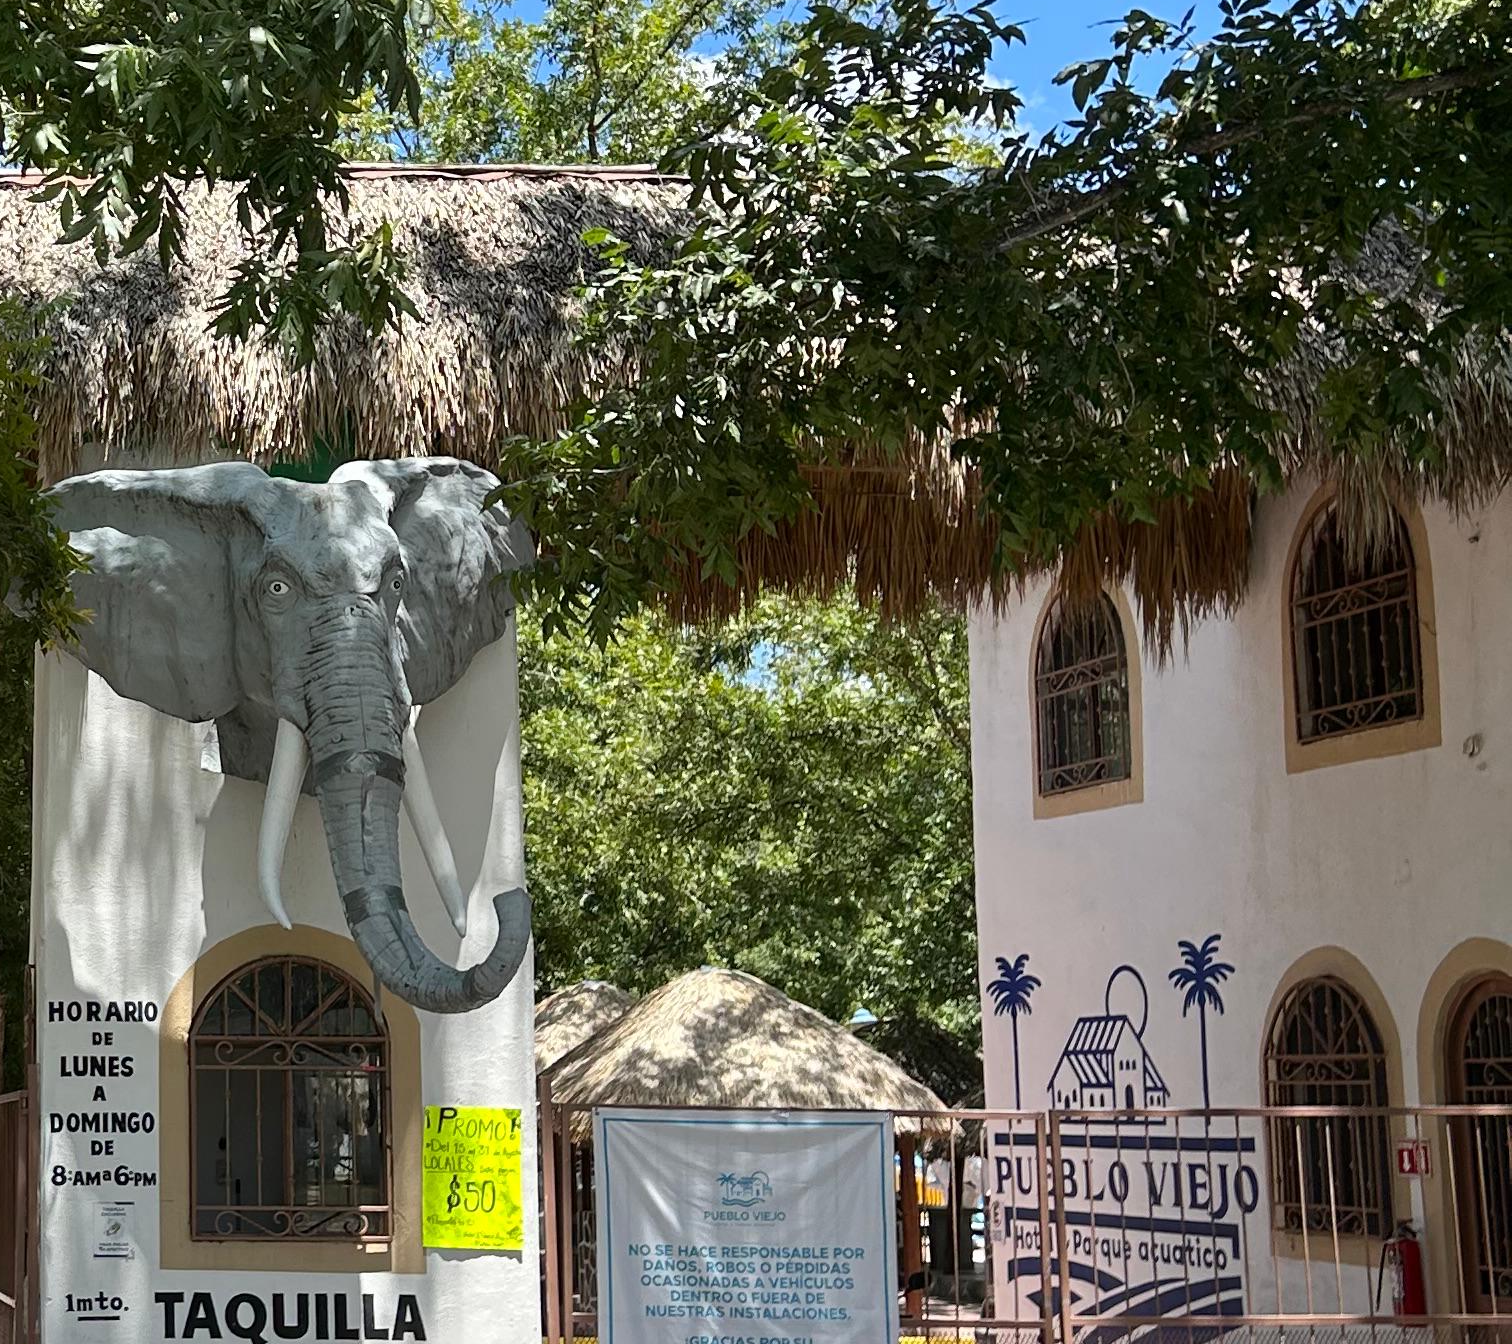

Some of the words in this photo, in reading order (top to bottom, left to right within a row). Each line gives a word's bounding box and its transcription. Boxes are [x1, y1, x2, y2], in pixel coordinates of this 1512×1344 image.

[48, 1001, 158, 1023] HORARIO
[92, 1032, 114, 1046] DE
[60, 1056, 134, 1077] LUNES
[92, 1085, 107, 1102] A
[49, 1112, 155, 1133] DOMINGO
[90, 1140, 114, 1156] DE
[447, 1174, 496, 1213] $50
[1142, 1161, 1259, 1219] VIEJO
[704, 1211, 750, 1221] PUEBLO
[753, 1211, 786, 1221] VIEJO
[1015, 1225, 1054, 1252] Hotl
[628, 1244, 651, 1256] NO
[655, 1245, 673, 1256] SE
[678, 1246, 717, 1258] HACE
[721, 1246, 829, 1259] RESPONSABLE
[833, 1248, 865, 1259] POR
[642, 1257, 702, 1273] DAÑOS,
[706, 1262, 756, 1273] ROBOS
[760, 1262, 772, 1273] O
[776, 1259, 851, 1274] PÉRDIDAS
[640, 1275, 750, 1288] OCASIONADAS
[754, 1277, 765, 1288] A
[769, 1274, 854, 1289] VEHÍCULOS
[670, 1290, 733, 1303] DENTRO
[737, 1292, 748, 1303] O
[752, 1292, 801, 1304] FUERA
[805, 1293, 826, 1304] DE
[645, 1306, 725, 1318] NUESTRAS
